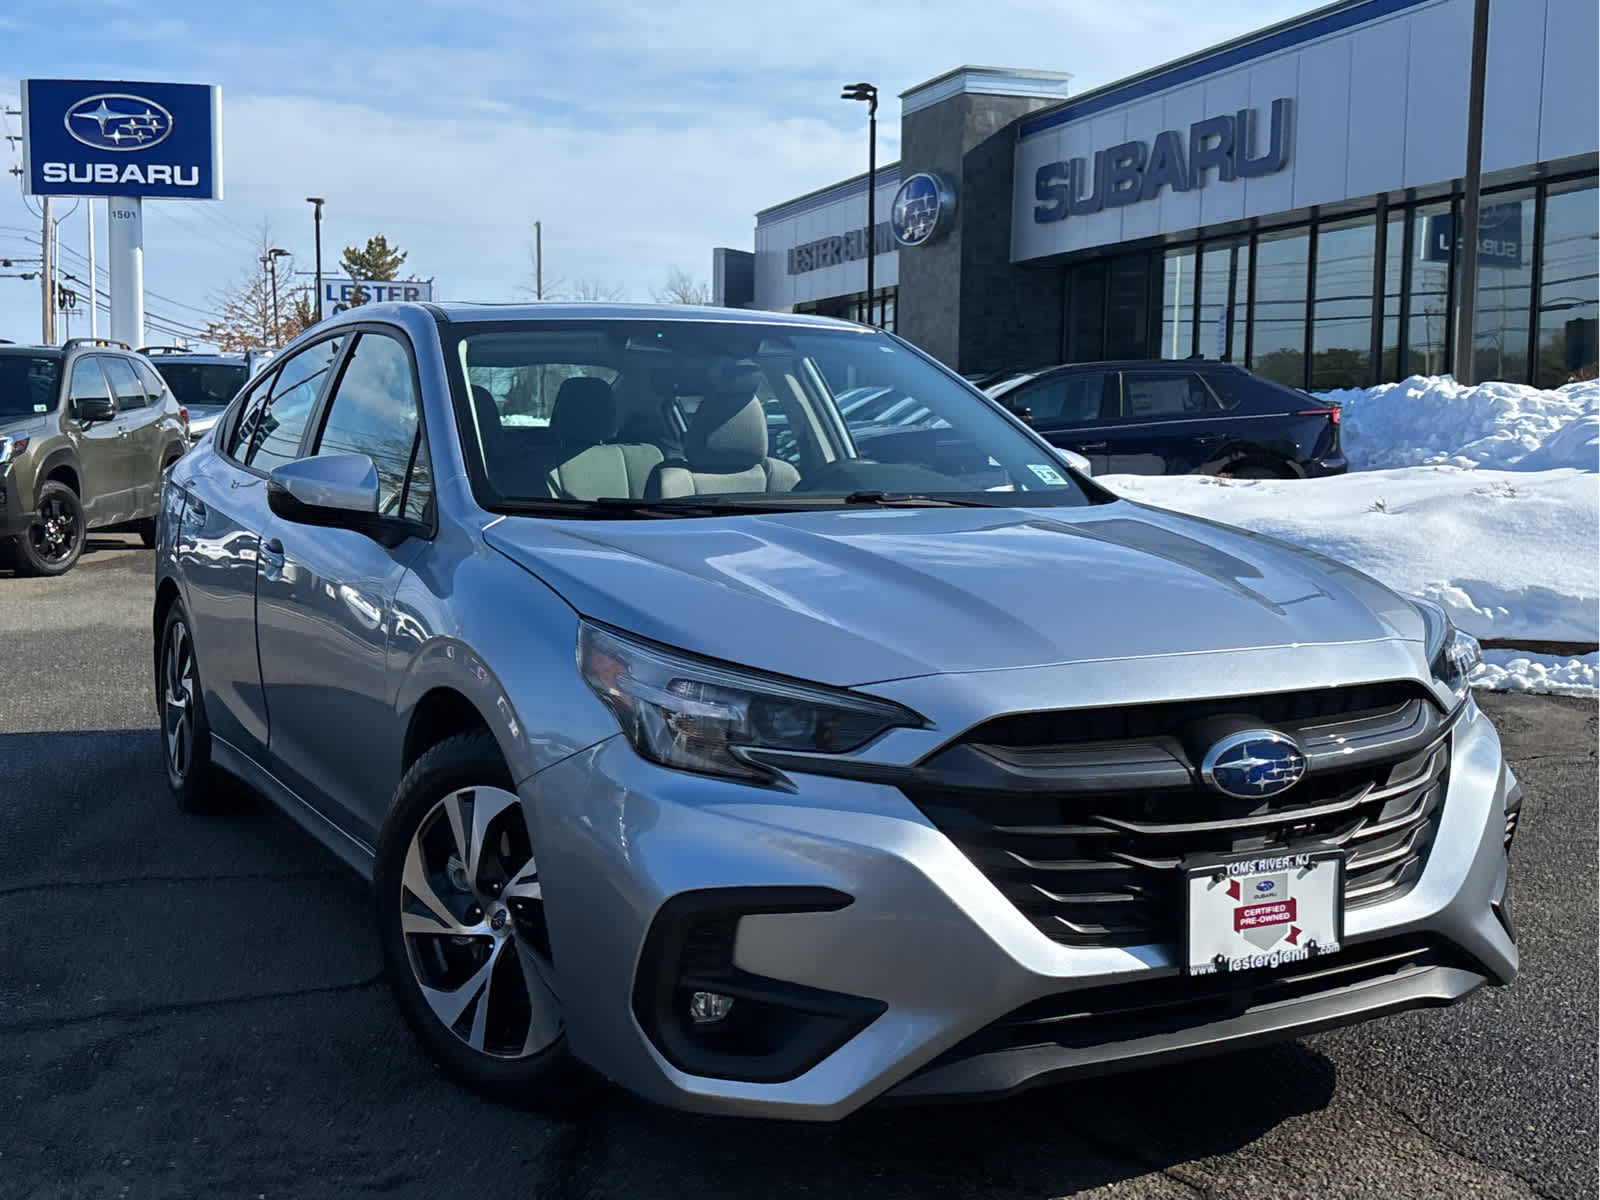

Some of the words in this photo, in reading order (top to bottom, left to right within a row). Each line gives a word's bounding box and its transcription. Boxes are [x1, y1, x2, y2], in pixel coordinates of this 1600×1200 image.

[1034, 98, 1292, 224] SUBARU
[43, 161, 199, 186] SUBARU
[112, 210, 137, 220] 1501
[326, 284, 420, 304] LESTER
[1225, 862, 1256, 876] TOMS
[1296, 854, 1311, 866] NJ
[1240, 912, 1291, 926] PRE-OWNED
[1243, 904, 1287, 917] CERTIFIED
